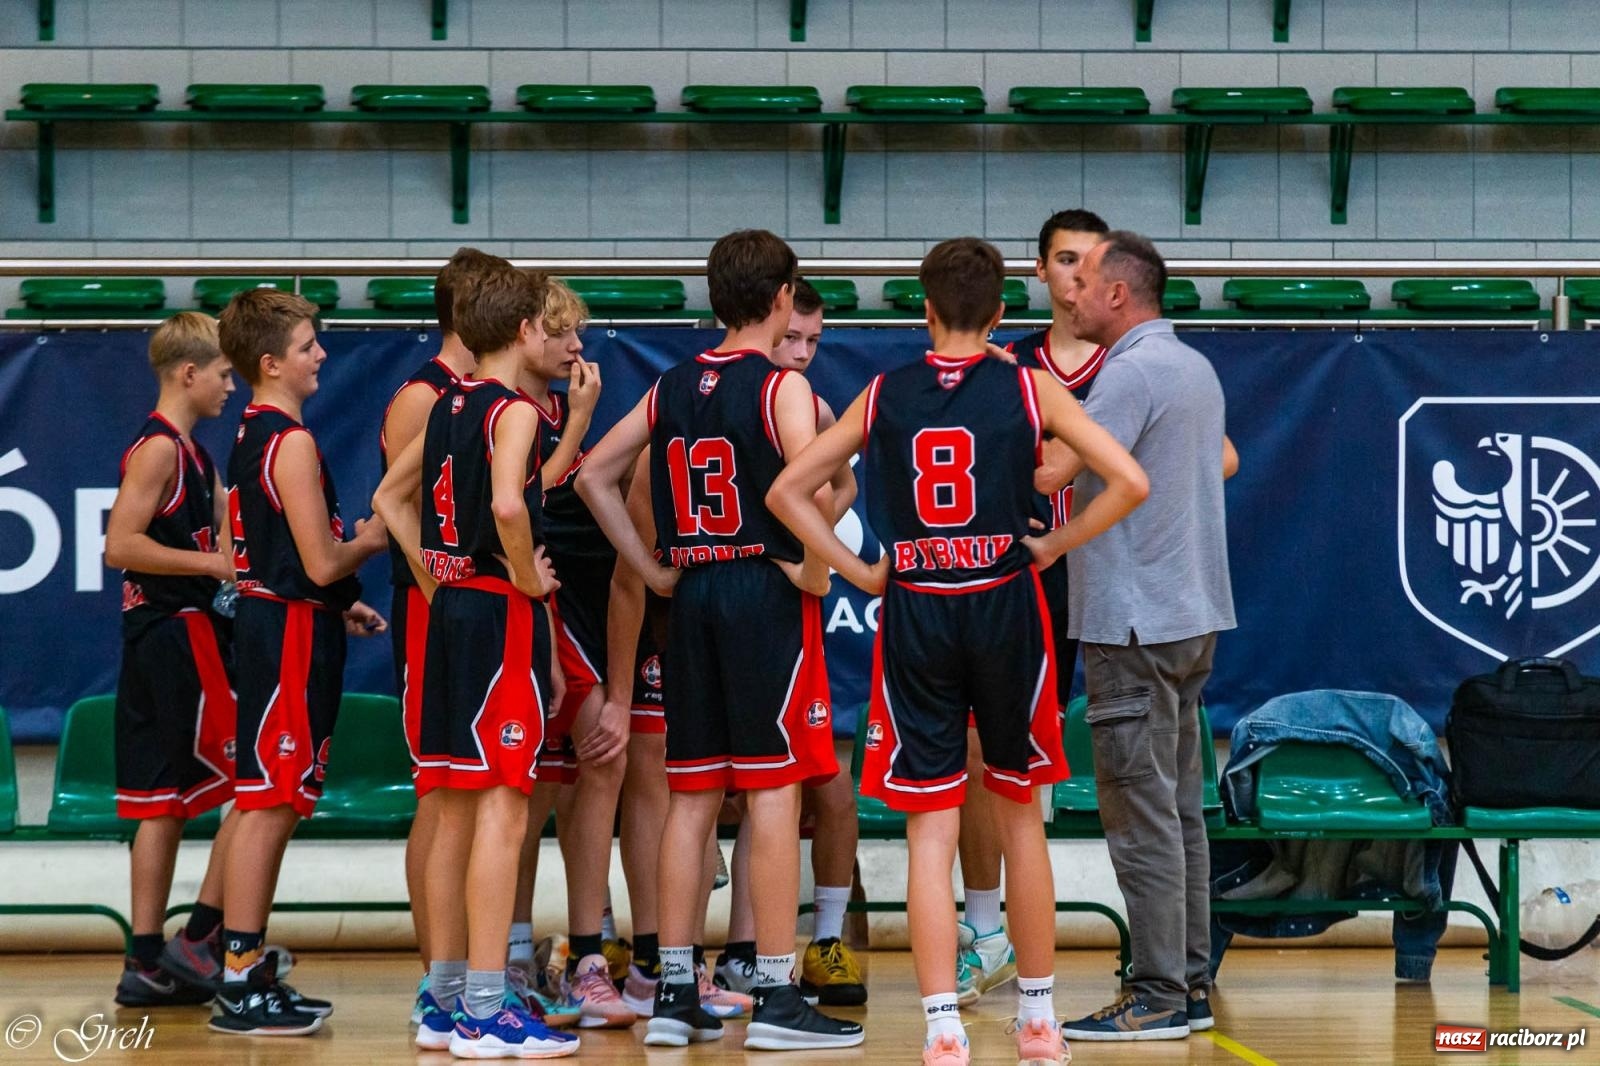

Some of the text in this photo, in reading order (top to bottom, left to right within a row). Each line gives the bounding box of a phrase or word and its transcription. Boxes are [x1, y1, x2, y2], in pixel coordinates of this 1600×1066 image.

[432, 455, 460, 548] 4
[667, 437, 743, 536] 13
[912, 426, 976, 528] 8
